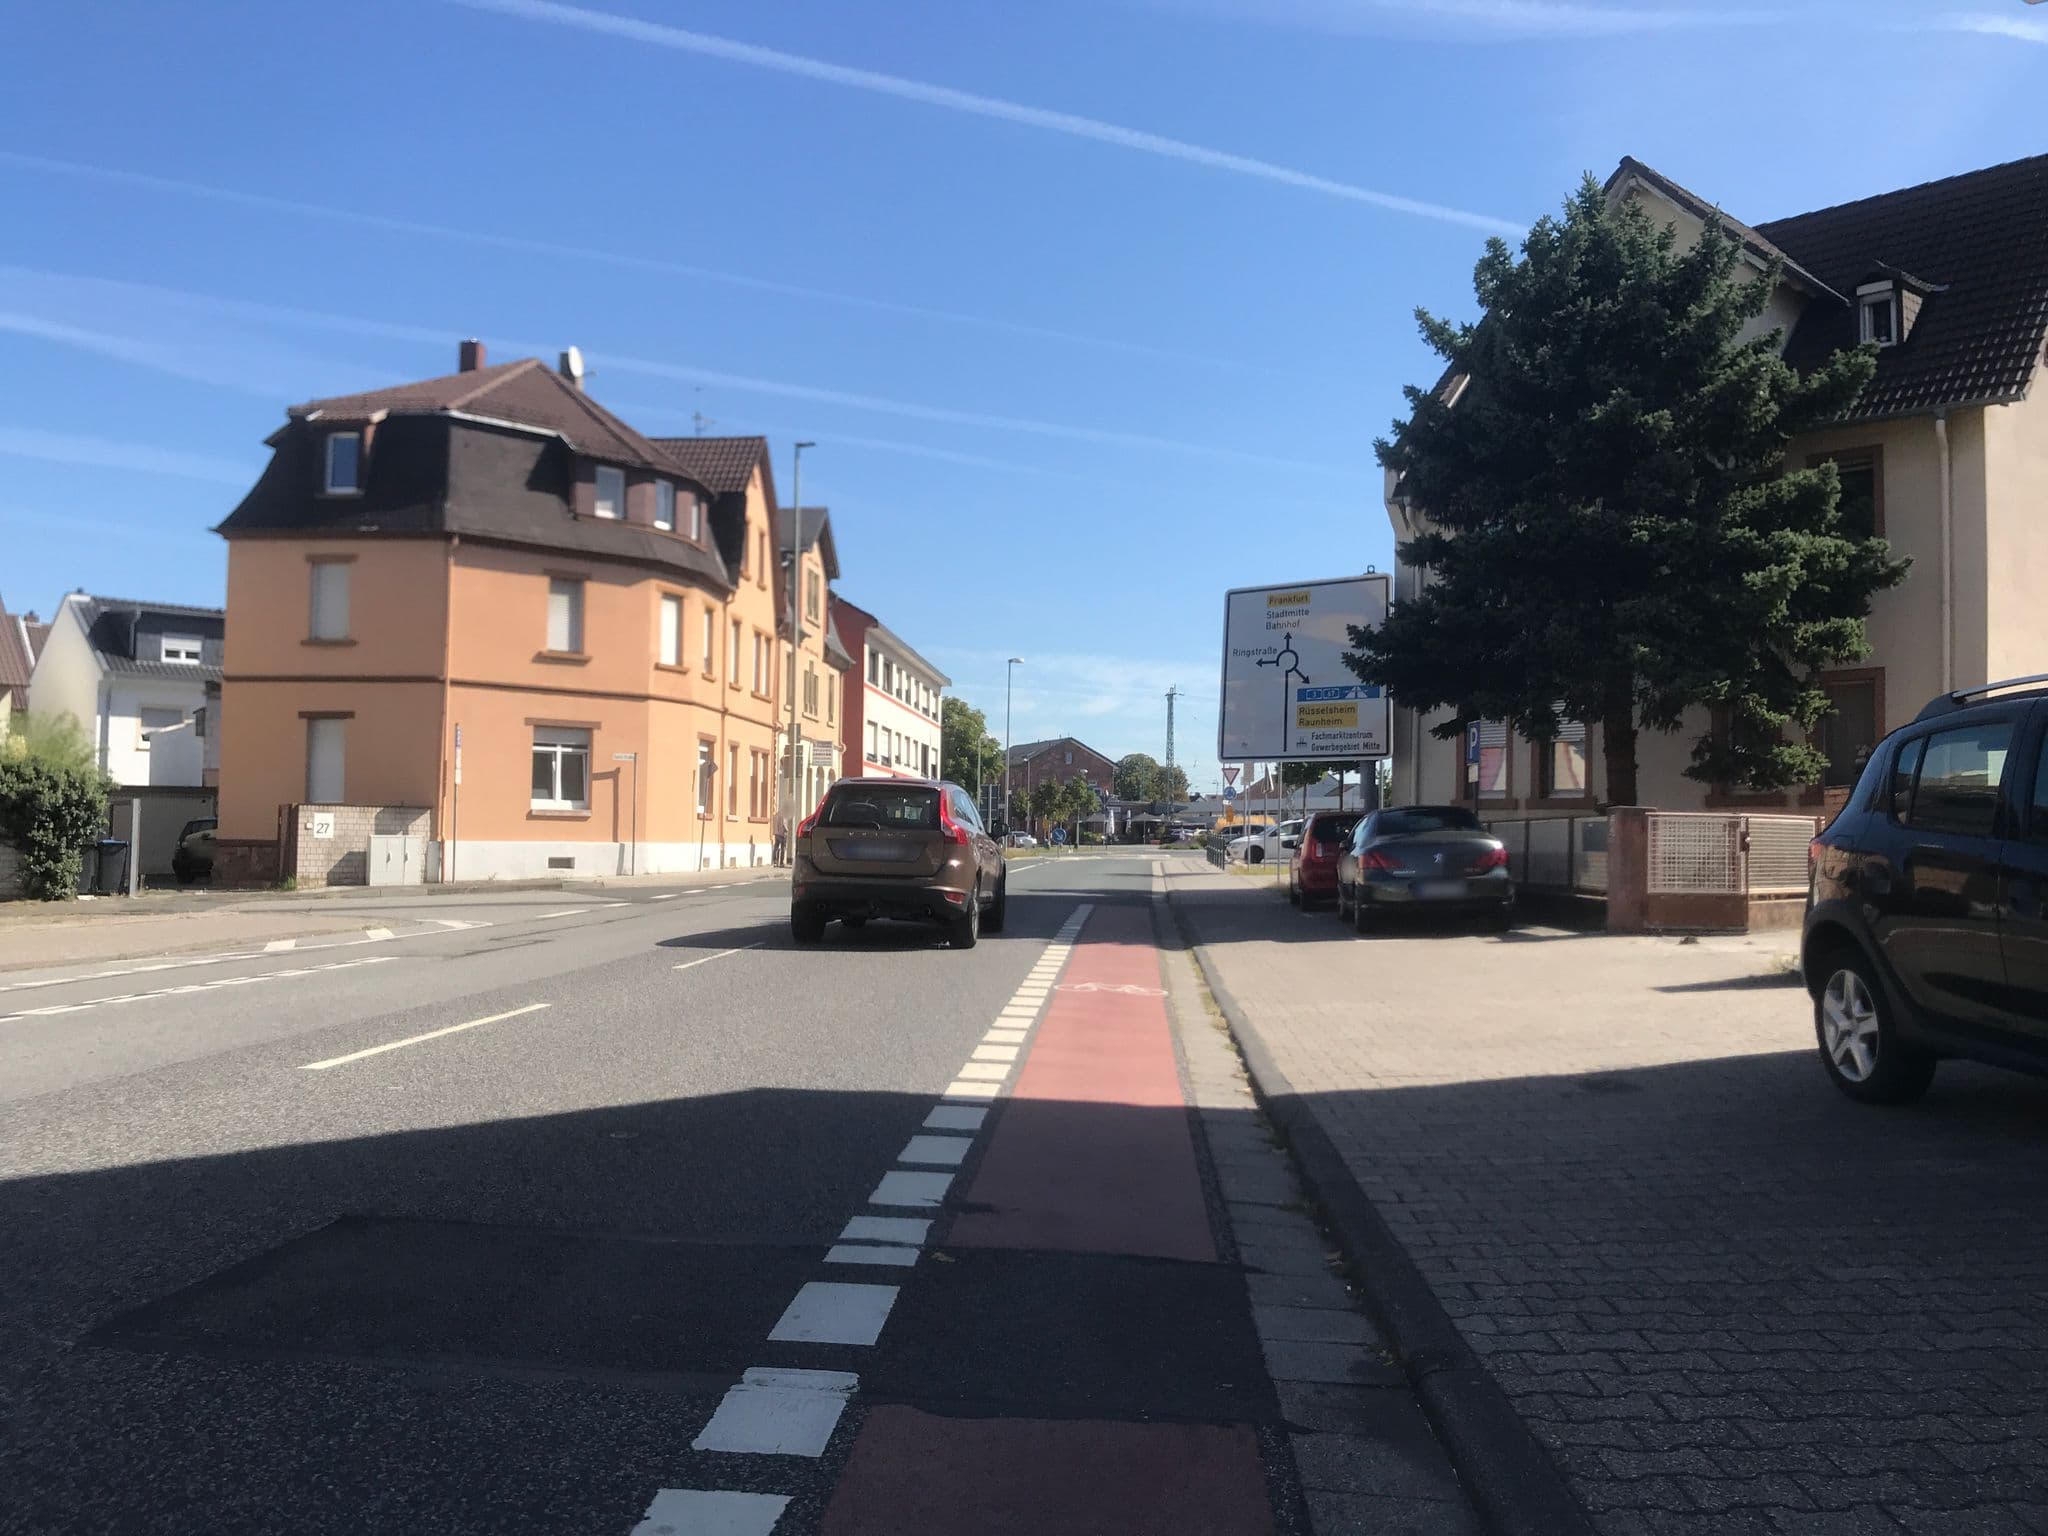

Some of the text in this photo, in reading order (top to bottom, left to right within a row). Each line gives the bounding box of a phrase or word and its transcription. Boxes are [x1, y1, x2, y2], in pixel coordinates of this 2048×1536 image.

[1266, 608, 1310, 619] Stadtmitte
[1266, 619, 1300, 630] Bahnhof
[1232, 646, 1278, 658] Ringstraße
[1299, 705, 1356, 715] Rüsselsheim
[1298, 717, 1343, 727] Raunheim
[1311, 731, 1373, 741] Fachmarktzentrum
[1362, 741, 1381, 751] Mitte
[1469, 727, 1478, 759] P
[316, 822, 330, 834] 27
